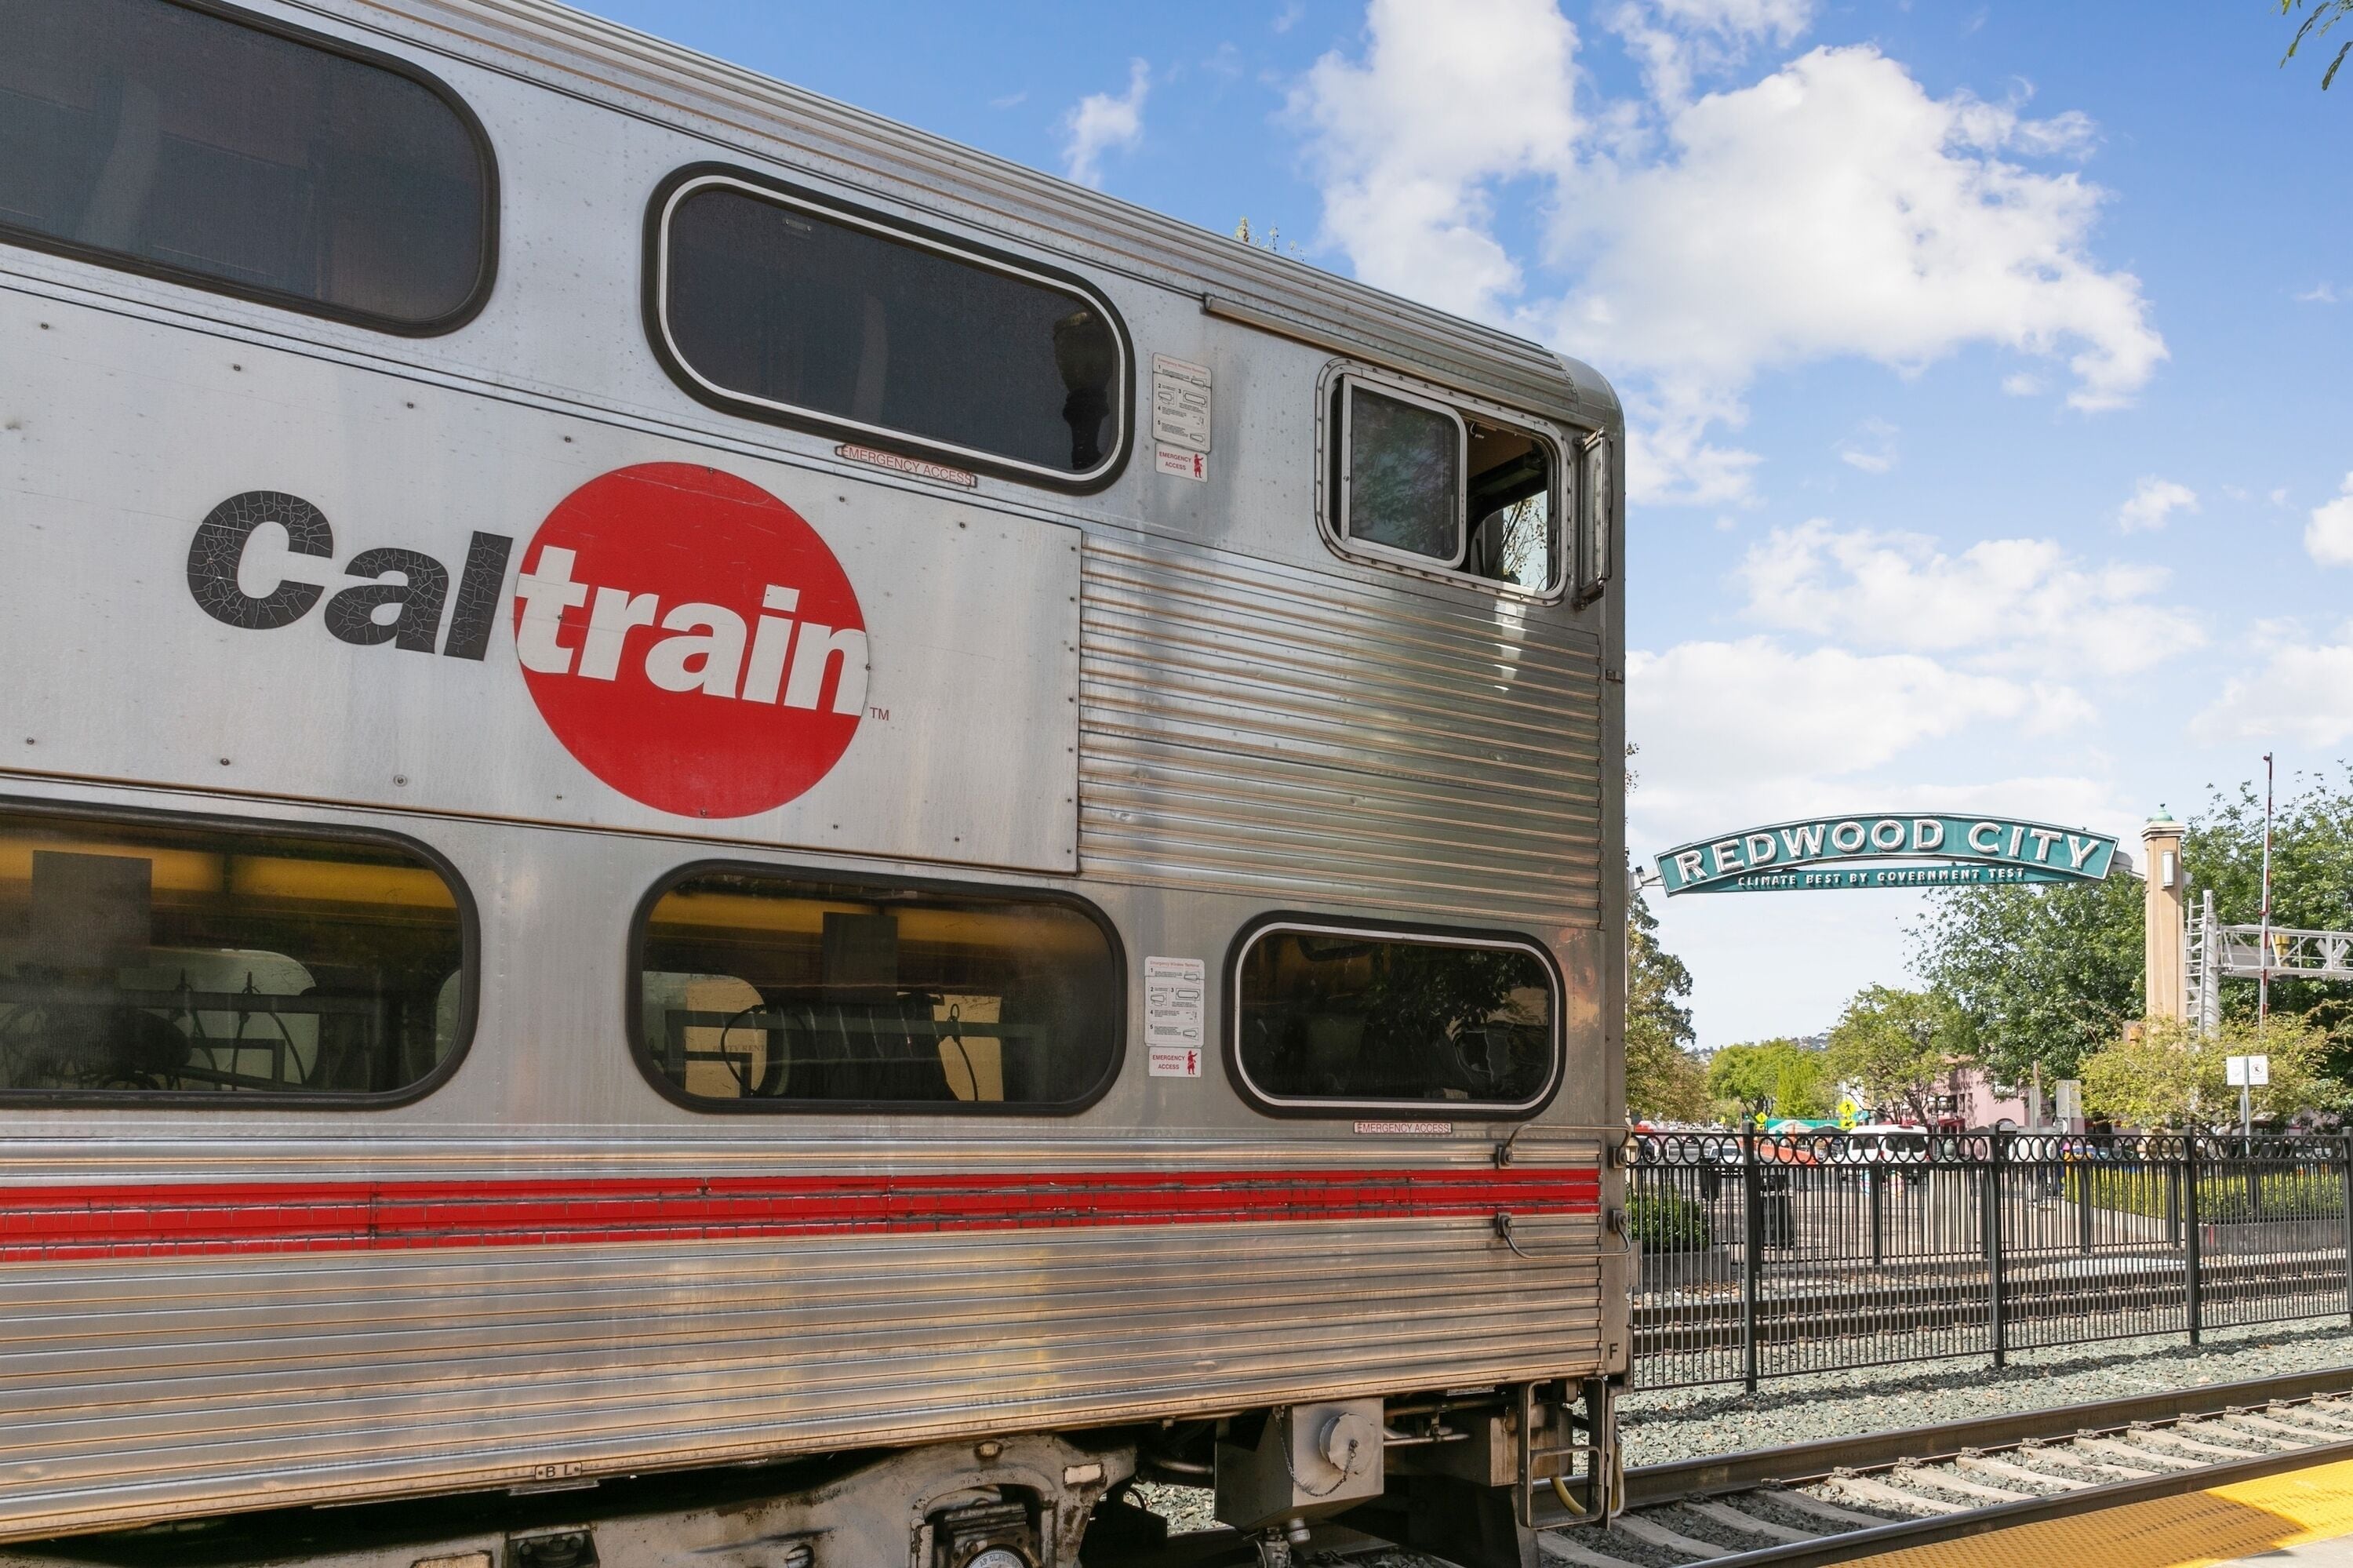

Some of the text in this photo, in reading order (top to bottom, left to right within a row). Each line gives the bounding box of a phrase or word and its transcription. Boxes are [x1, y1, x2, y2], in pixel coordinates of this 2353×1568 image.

[1158, 451, 1191, 463] EMERGENCY
[842, 446, 972, 486] EMERGENCY ACCESS
[1165, 461, 1187, 471] ACCESS
[869, 707, 889, 722] TM
[1673, 819, 2101, 883] REDWOOD CITY
[1737, 868, 2024, 888] CLIMATE BEST BY GOVERNMENT TEST
[1357, 1123, 1449, 1133] EMERGENCY ACCESS
[1609, 1342, 1618, 1359] F
